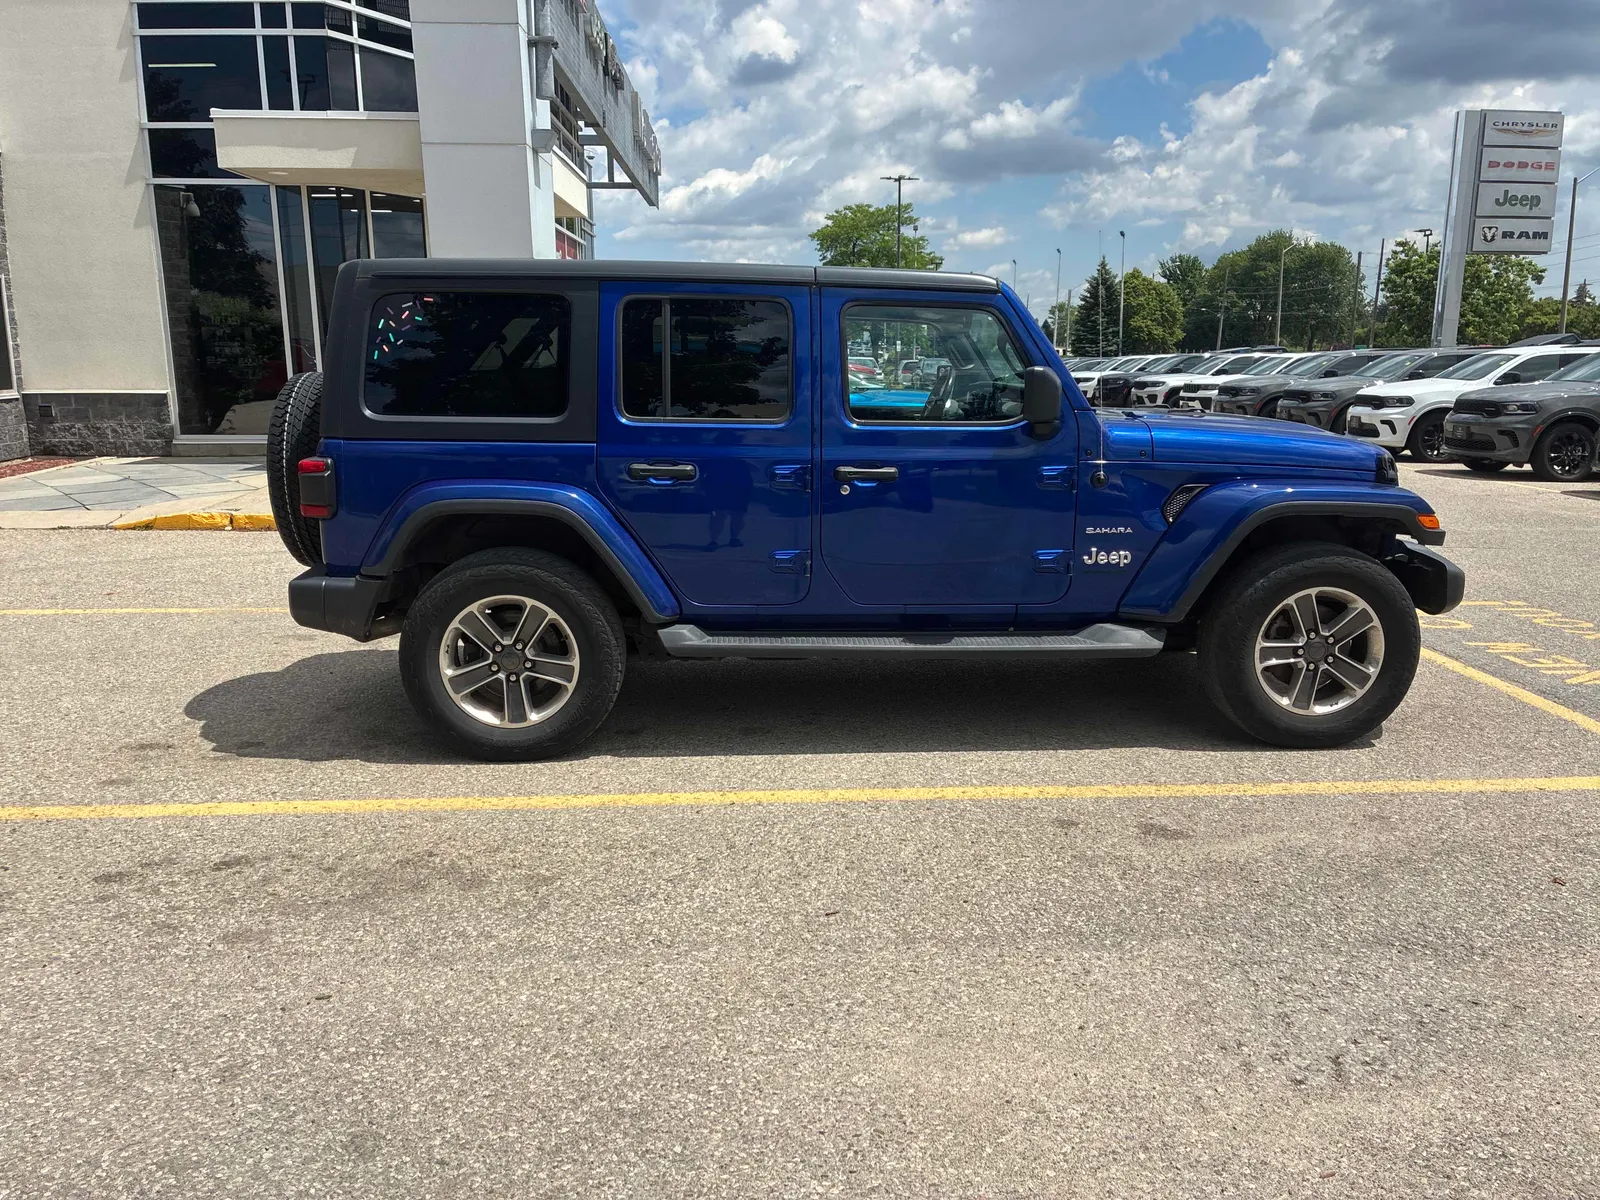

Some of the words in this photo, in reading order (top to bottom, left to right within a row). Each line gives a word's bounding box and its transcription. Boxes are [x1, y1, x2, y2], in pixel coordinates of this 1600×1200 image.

[1492, 121, 1558, 129] CHRYSLER
[1487, 160, 1556, 171] DODGE
[1494, 189, 1541, 211] Jeep
[1501, 230, 1549, 240] RAM
[1083, 547, 1132, 567] Jeep
